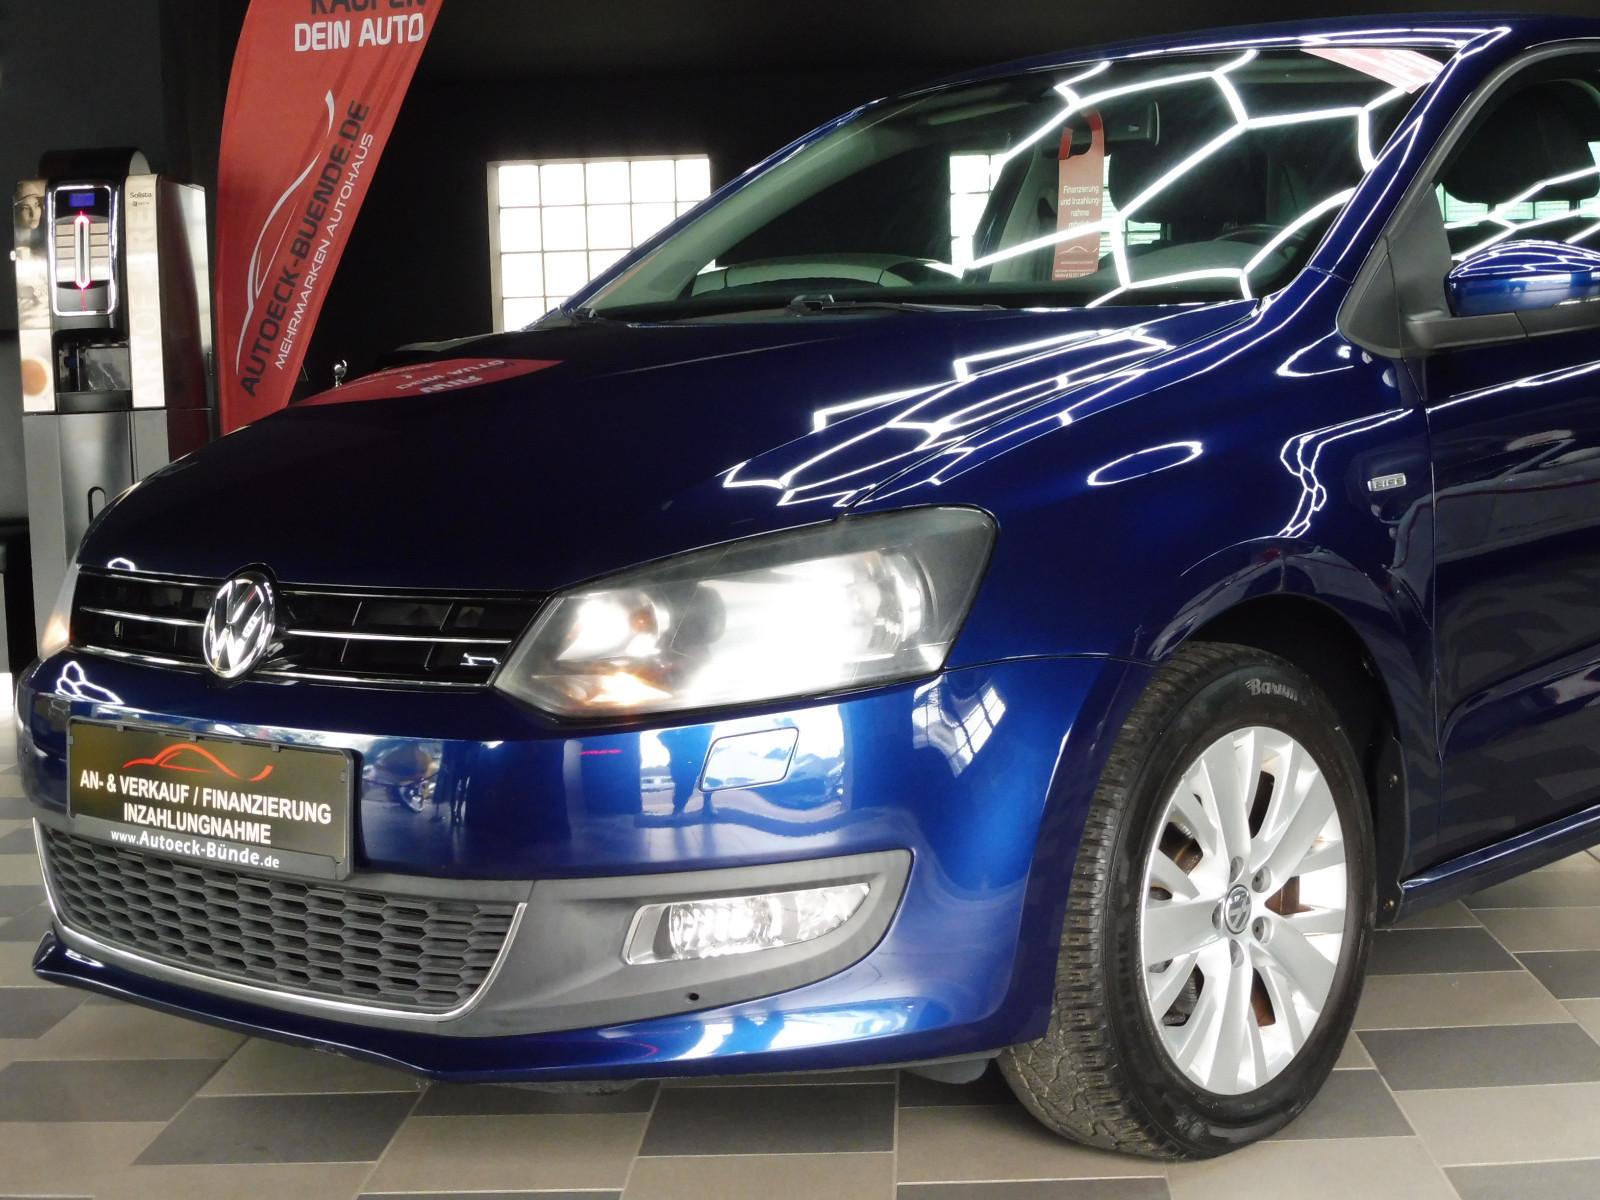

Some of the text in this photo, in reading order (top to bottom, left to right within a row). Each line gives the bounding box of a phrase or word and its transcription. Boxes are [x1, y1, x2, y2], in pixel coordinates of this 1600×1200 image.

[294, 12, 424, 52] DEIN AUTO
[240, 100, 369, 397] AUTOECK-BUENDE.DE
[274, 133, 374, 370] MEHRMARKEN AUTOHAUS
[80, 770, 104, 789] AN-
[107, 774, 117, 793] &
[120, 775, 190, 803] VERKAUF
[202, 788, 332, 824] FINANZIERUNG
[123, 803, 272, 845] INZAHLUNGNAHME
[110, 830, 280, 869] www.Autoeck-Bünde.de
